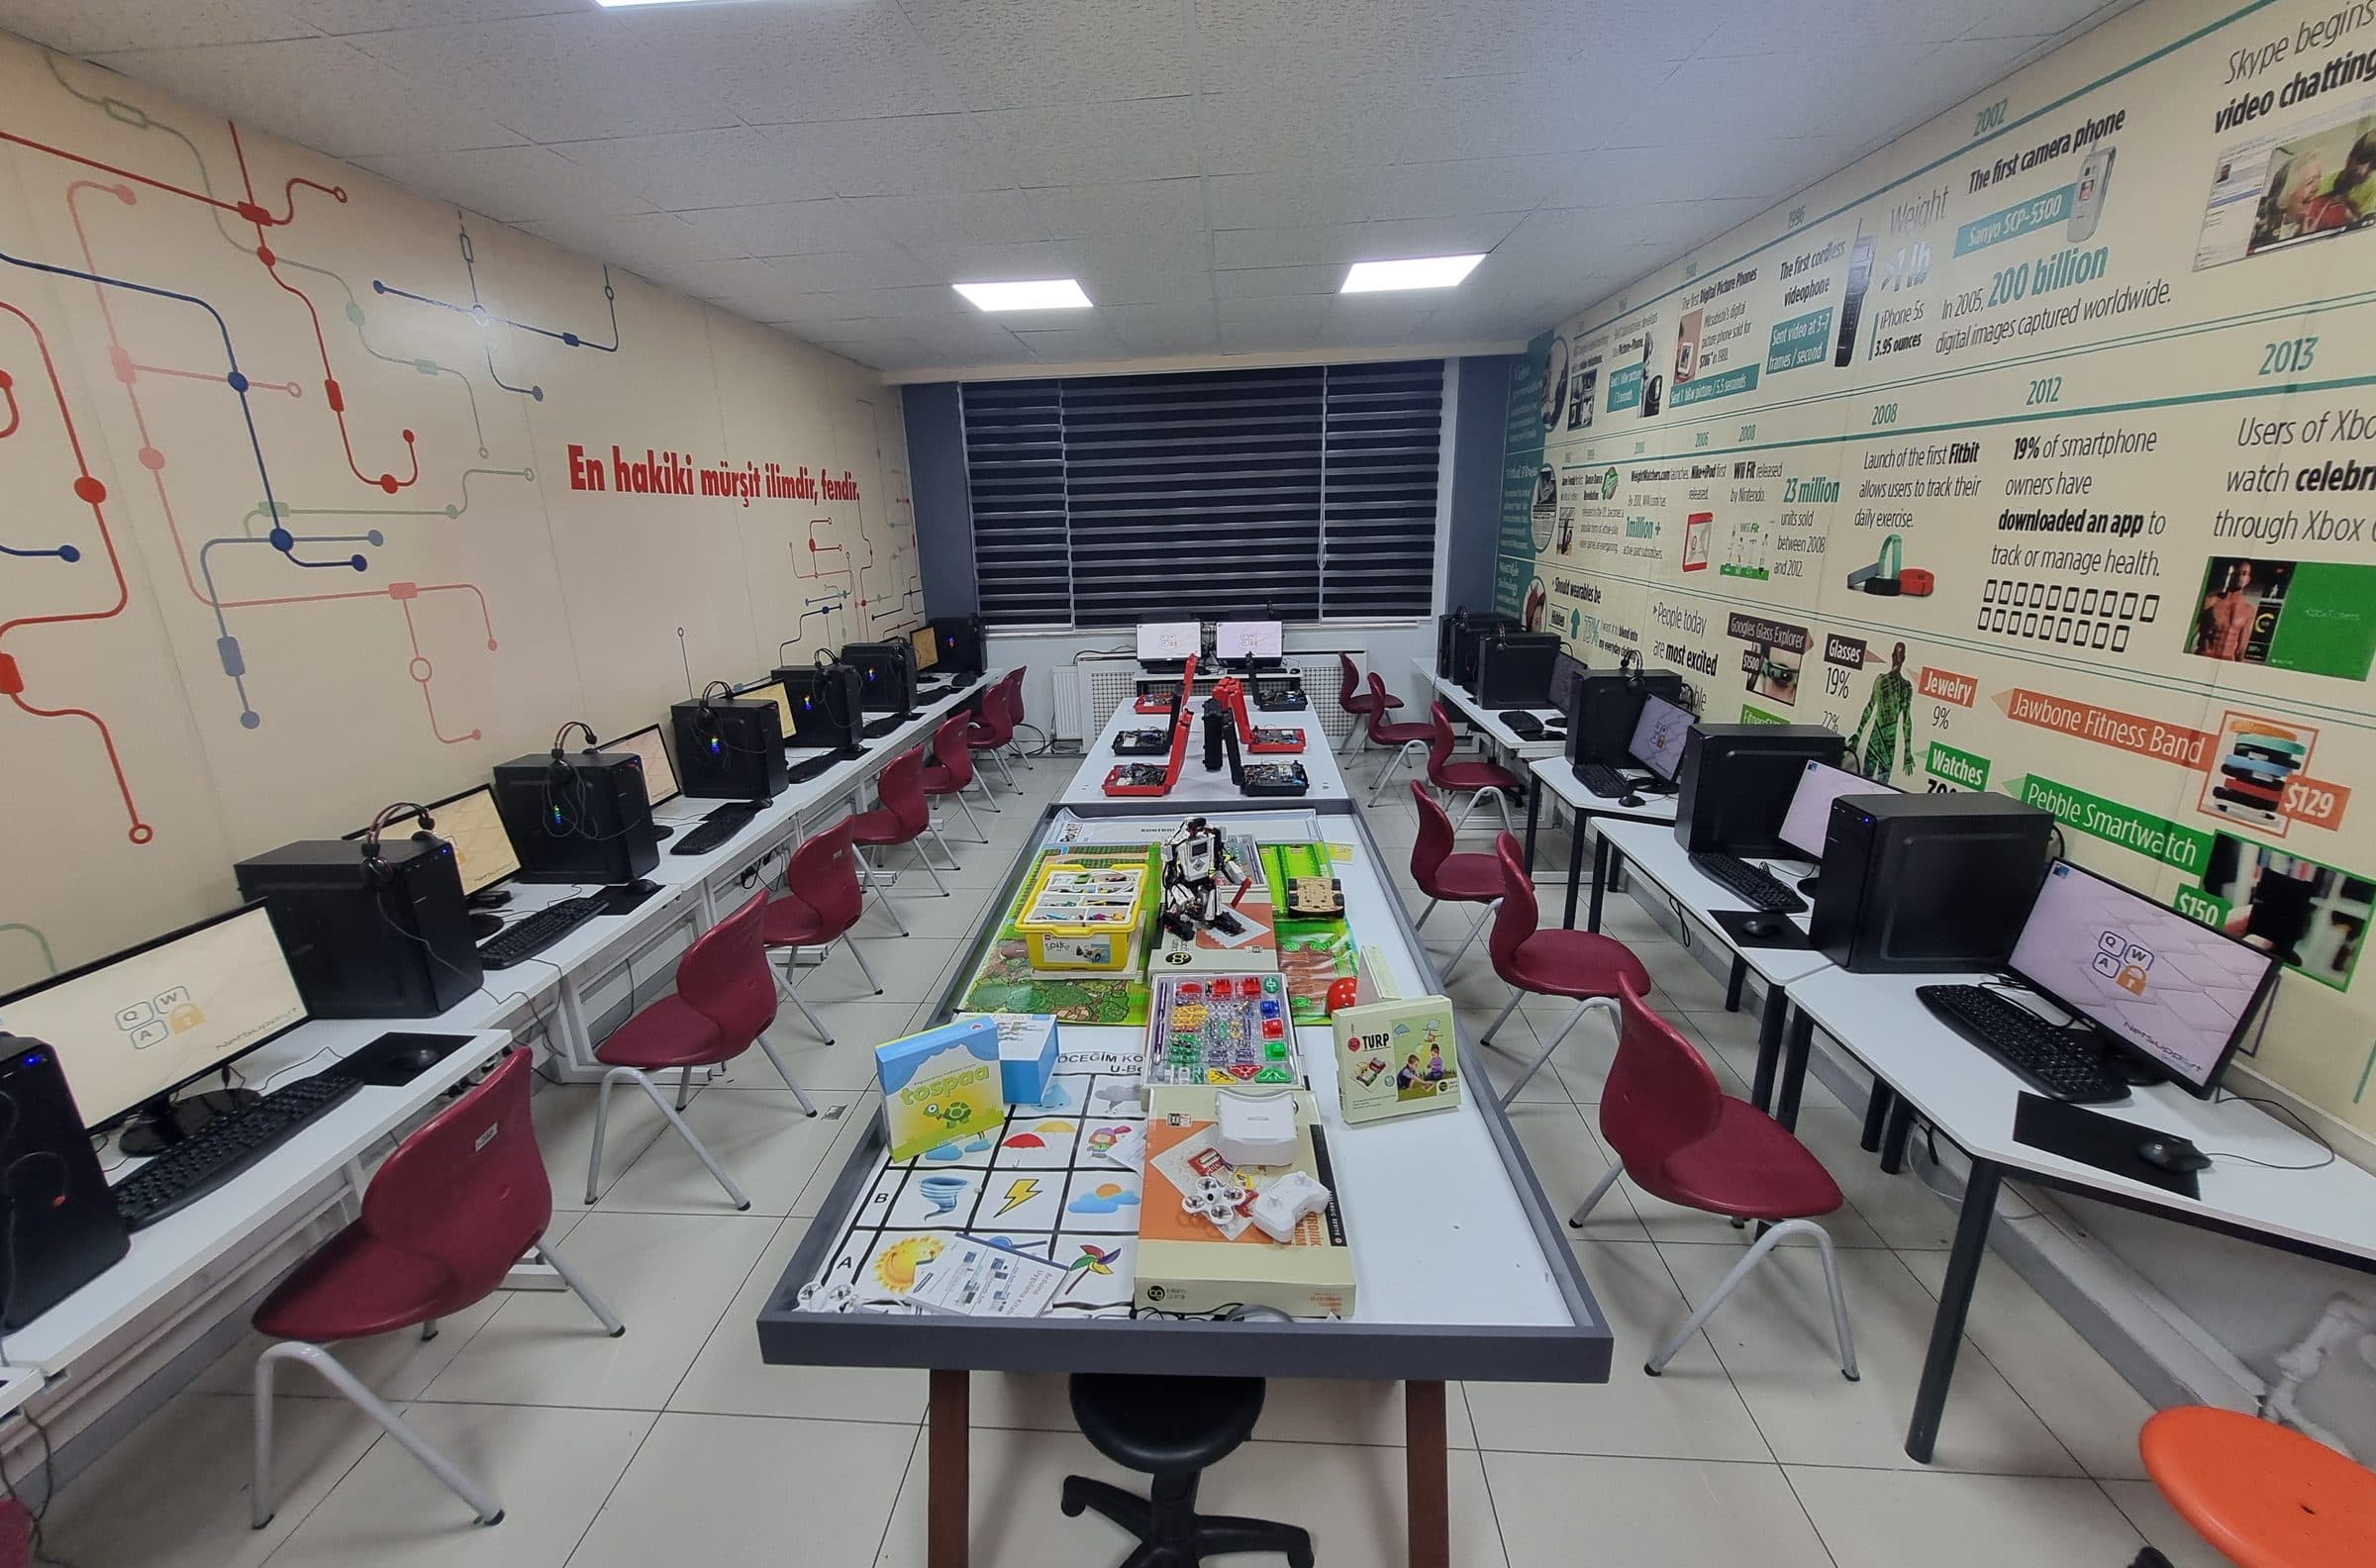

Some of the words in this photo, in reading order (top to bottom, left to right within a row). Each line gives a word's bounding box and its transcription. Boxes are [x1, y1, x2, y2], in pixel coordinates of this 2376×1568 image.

[2225, 37, 2290, 85] Skype
[2295, 0, 2375, 54] begins
[2214, 90, 2275, 134] video
[2280, 49, 2376, 109] chatting
[1973, 98, 2010, 138] 2002
[1968, 167, 1991, 196] The
[1992, 153, 2021, 185] first
[2021, 137, 2072, 169] camera
[2075, 108, 2127, 154] phone
[1890, 186, 1949, 233] Weight
[1967, 221, 2001, 249] Sanyo
[2002, 192, 2063, 236] SCP-5300
[1780, 259, 1793, 281] The
[1793, 252, 1811, 275] first
[1699, 283, 1717, 305] Digital
[1717, 277, 1735, 297] Picture
[1736, 268, 1758, 290] Phones
[1784, 277, 1830, 307] videophone
[1941, 299, 1953, 322] In
[1953, 288, 1985, 317] 2005,
[1988, 261, 2030, 309] 200
[2031, 245, 2110, 297] billion
[1880, 307, 1911, 331] iPhone
[1912, 300, 1926, 322] 5s
[1935, 323, 1972, 355] digital
[1972, 318, 2016, 348] images
[2018, 298, 2081, 337] captured
[2083, 278, 2172, 322] worldwide.
[1772, 327, 1786, 346] Sent
[1787, 322, 1808, 343] video
[1808, 320, 1816, 337] at
[1874, 338, 1892, 357] 3.95
[1893, 333, 1923, 353] ounces
[1769, 352, 1791, 373] frames
[1797, 344, 1823, 365] second
[2259, 336, 2321, 376] 2013
[2027, 376, 2063, 406] 2012
[1871, 402, 1899, 427] 2008
[2238, 416, 2298, 446] Users
[2302, 410, 2331, 443] of
[1863, 448, 1897, 471] Launch
[1897, 447, 1909, 468] of
[1909, 446, 1927, 467] the
[1927, 443, 1947, 466] first
[1948, 441, 1981, 465] Fitbit
[2013, 436, 2041, 461] 19%
[2042, 435, 2059, 459] of
[2060, 428, 2158, 460] smartphone
[567, 443, 606, 491] En
[612, 444, 695, 495] hakiki
[700, 460, 761, 508] mürşit
[765, 462, 820, 507] ilimdir,
[821, 468, 860, 502] fendir.
[1733, 461, 1745, 480] Wii
[1756, 459, 1783, 479] released
[2005, 478, 2053, 498] owners
[2056, 470, 2093, 497] have
[2227, 462, 2290, 494] watch
[1731, 488, 1737, 503] by
[1783, 477, 1798, 503] 23
[1798, 476, 1840, 503] million
[1858, 478, 1887, 499] allows
[1888, 479, 1913, 498] users
[1914, 478, 1926, 498] to
[1926, 476, 1952, 498] track
[1954, 474, 1982, 498] their
[1781, 511, 1797, 527] units
[1798, 510, 1815, 527] sold
[1854, 507, 1876, 531] daily
[1876, 511, 1915, 530] exercise.
[1998, 509, 2085, 535] downloaded
[2087, 513, 2112, 535] an
[2113, 513, 2144, 539] app
[2148, 511, 2167, 536] to
[2213, 508, 2299, 546] through
[2302, 509, 2365, 542] Xbox
[1777, 535, 1806, 552] between
[1807, 536, 1827, 554] 2008
[1774, 560, 1787, 576] and
[1991, 543, 2022, 566] track
[2025, 549, 2039, 567] or
[2041, 550, 2103, 578] manage
[2107, 546, 2161, 578] health.
[1657, 601, 1682, 631] People
[1684, 608, 1708, 637] today
[1732, 617, 1755, 637] Googles
[1756, 622, 1773, 641] Glass
[1774, 628, 1806, 649] Explorer
[1653, 639, 1665, 659] are
[1665, 643, 1686, 665] most
[1687, 649, 1719, 676] excited
[1743, 653, 1760, 671] $1500
[1829, 638, 1862, 665] Glasses
[1825, 666, 1852, 700] 19%
[1925, 671, 1974, 705] Jewelry
[1931, 705, 1951, 731] 9%
[2013, 692, 2082, 732] Jawbone
[2084, 709, 2146, 748] Fitness
[2149, 725, 2207, 764] Band
[1931, 747, 1984, 787] Watches
[2284, 781, 2335, 818] $129
[2027, 782, 2082, 824] Pebble
[2083, 803, 2197, 868] Smartwatch
[2179, 891, 2220, 927] $150
[2098, 957, 2109, 968] A
[2106, 935, 2117, 947] Q
[2131, 948, 2147, 962] W
[160, 992, 178, 1006] W
[123, 1010, 139, 1022] Q
[140, 1029, 153, 1041] A
[1362, 1032, 1390, 1049] TURP
[899, 1065, 990, 1107] tospaa
[873, 1192, 890, 1204] B
[1306, 1214, 1324, 1246] TRONİK
[837, 1256, 852, 1270] A
